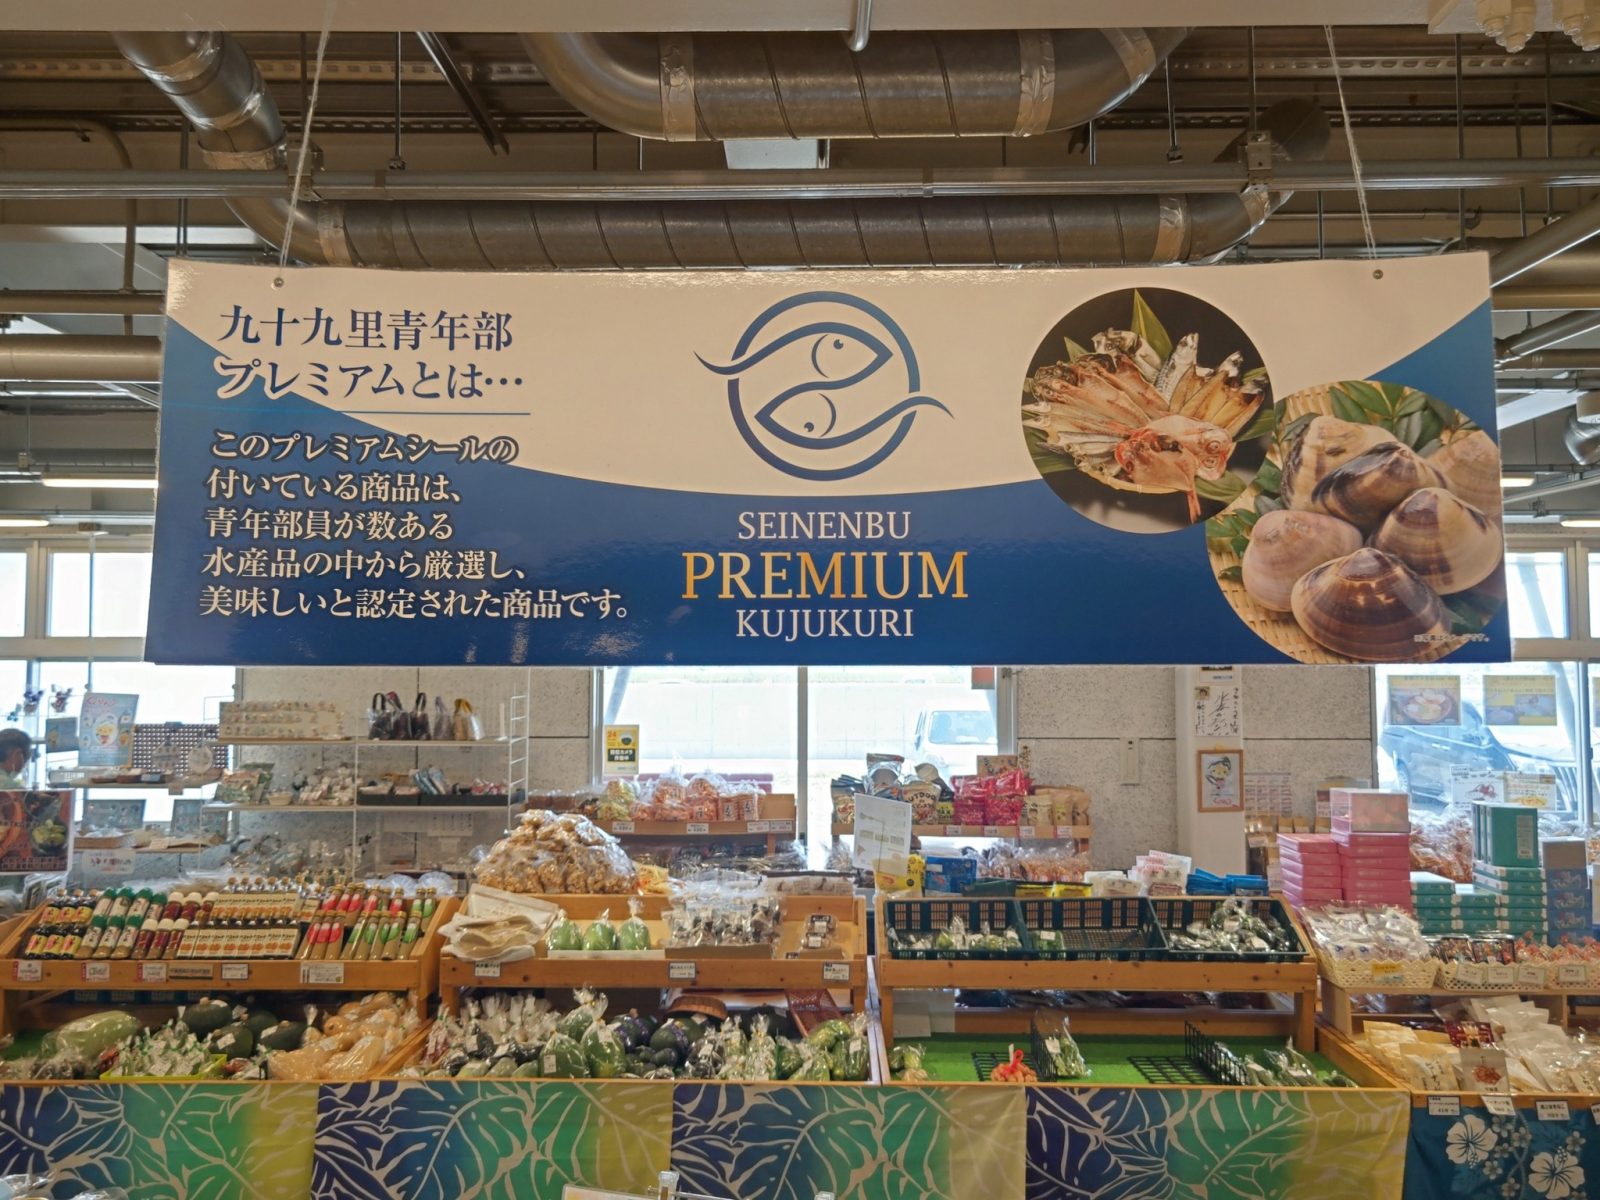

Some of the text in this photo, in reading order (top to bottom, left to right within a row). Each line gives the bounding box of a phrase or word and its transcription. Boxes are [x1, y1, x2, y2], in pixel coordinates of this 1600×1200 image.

[217, 305, 514, 352] 九十九里青年部
[211, 432, 518, 463] このプレミアムシールの
[205, 471, 463, 504] 付いている商品は、
[204, 508, 454, 541] 青年部員が数ある
[738, 511, 911, 540] SEINENBU
[201, 546, 527, 581] 水産品の中から厳選し、
[681, 551, 969, 599] PREMIUM
[199, 587, 628, 621] 美味しいと認定された商品です。
[736, 608, 915, 642] KUJUKURI
